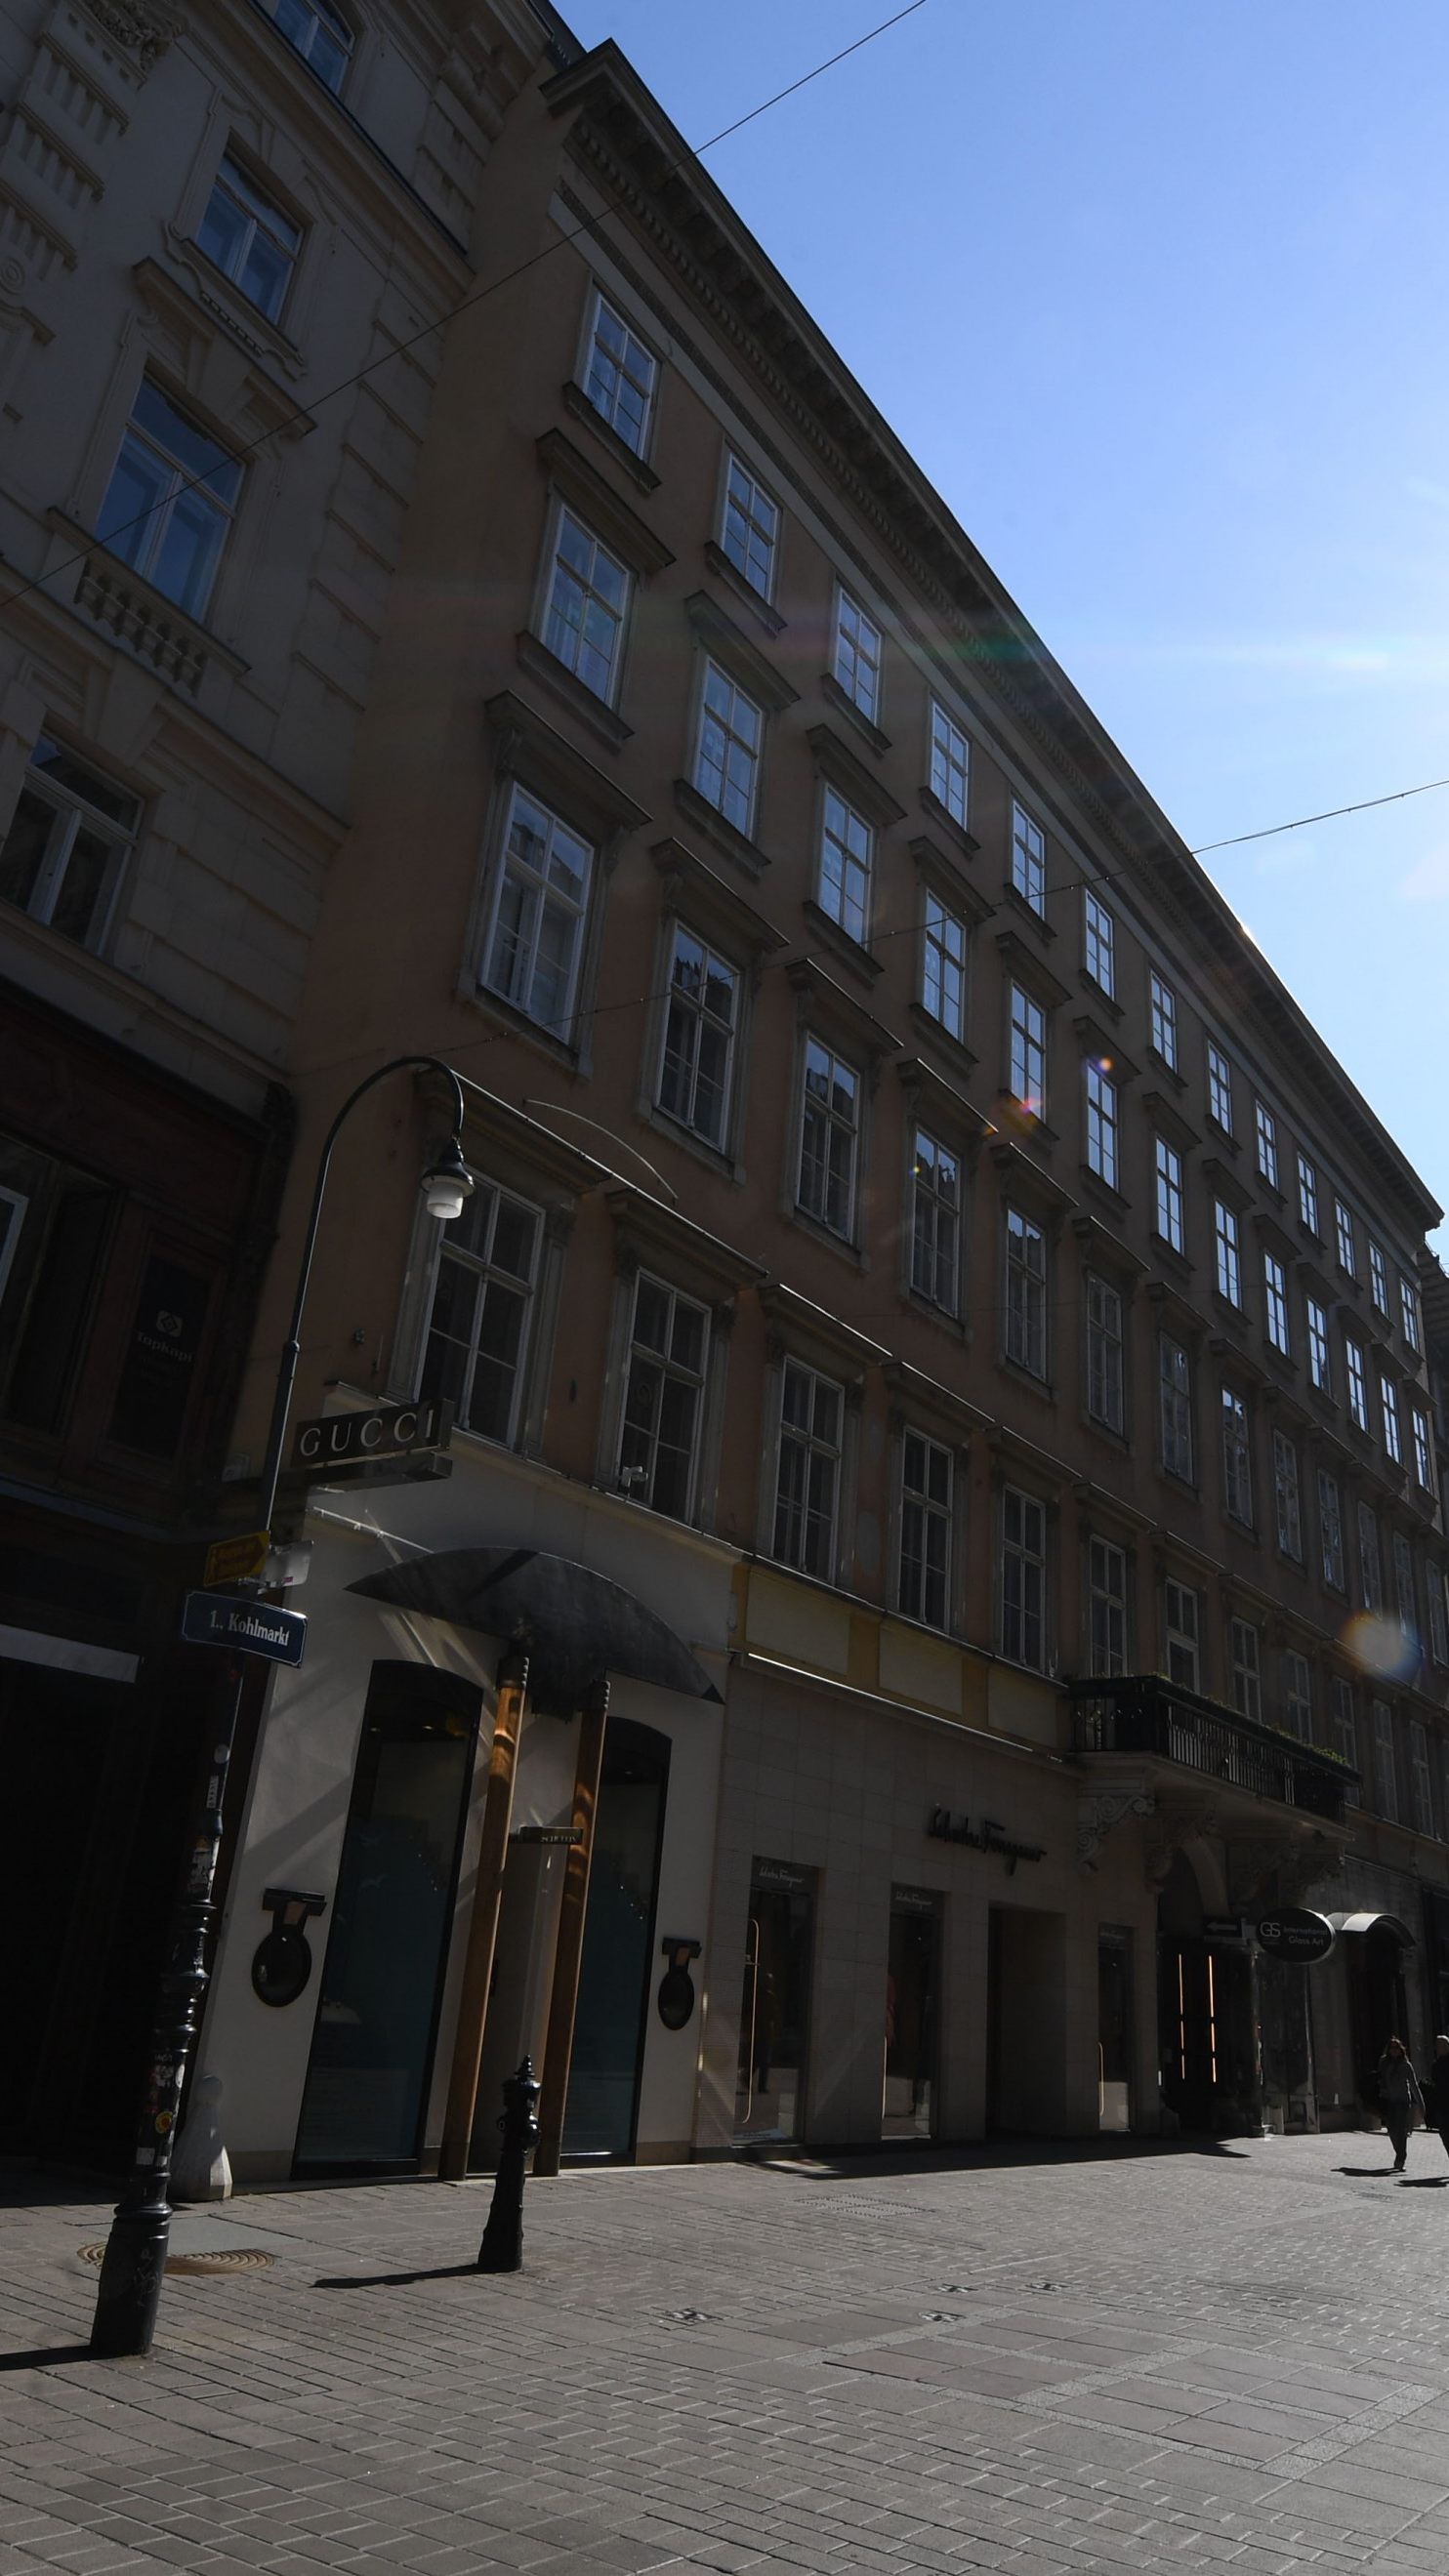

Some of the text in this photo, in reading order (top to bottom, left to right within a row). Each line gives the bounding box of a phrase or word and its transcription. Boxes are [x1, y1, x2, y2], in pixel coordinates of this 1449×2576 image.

[300, 1410, 435, 1456] GUCCI
[228, 1613, 290, 1647] Kohlmarkt
[1260, 1921, 1281, 1937] GS
